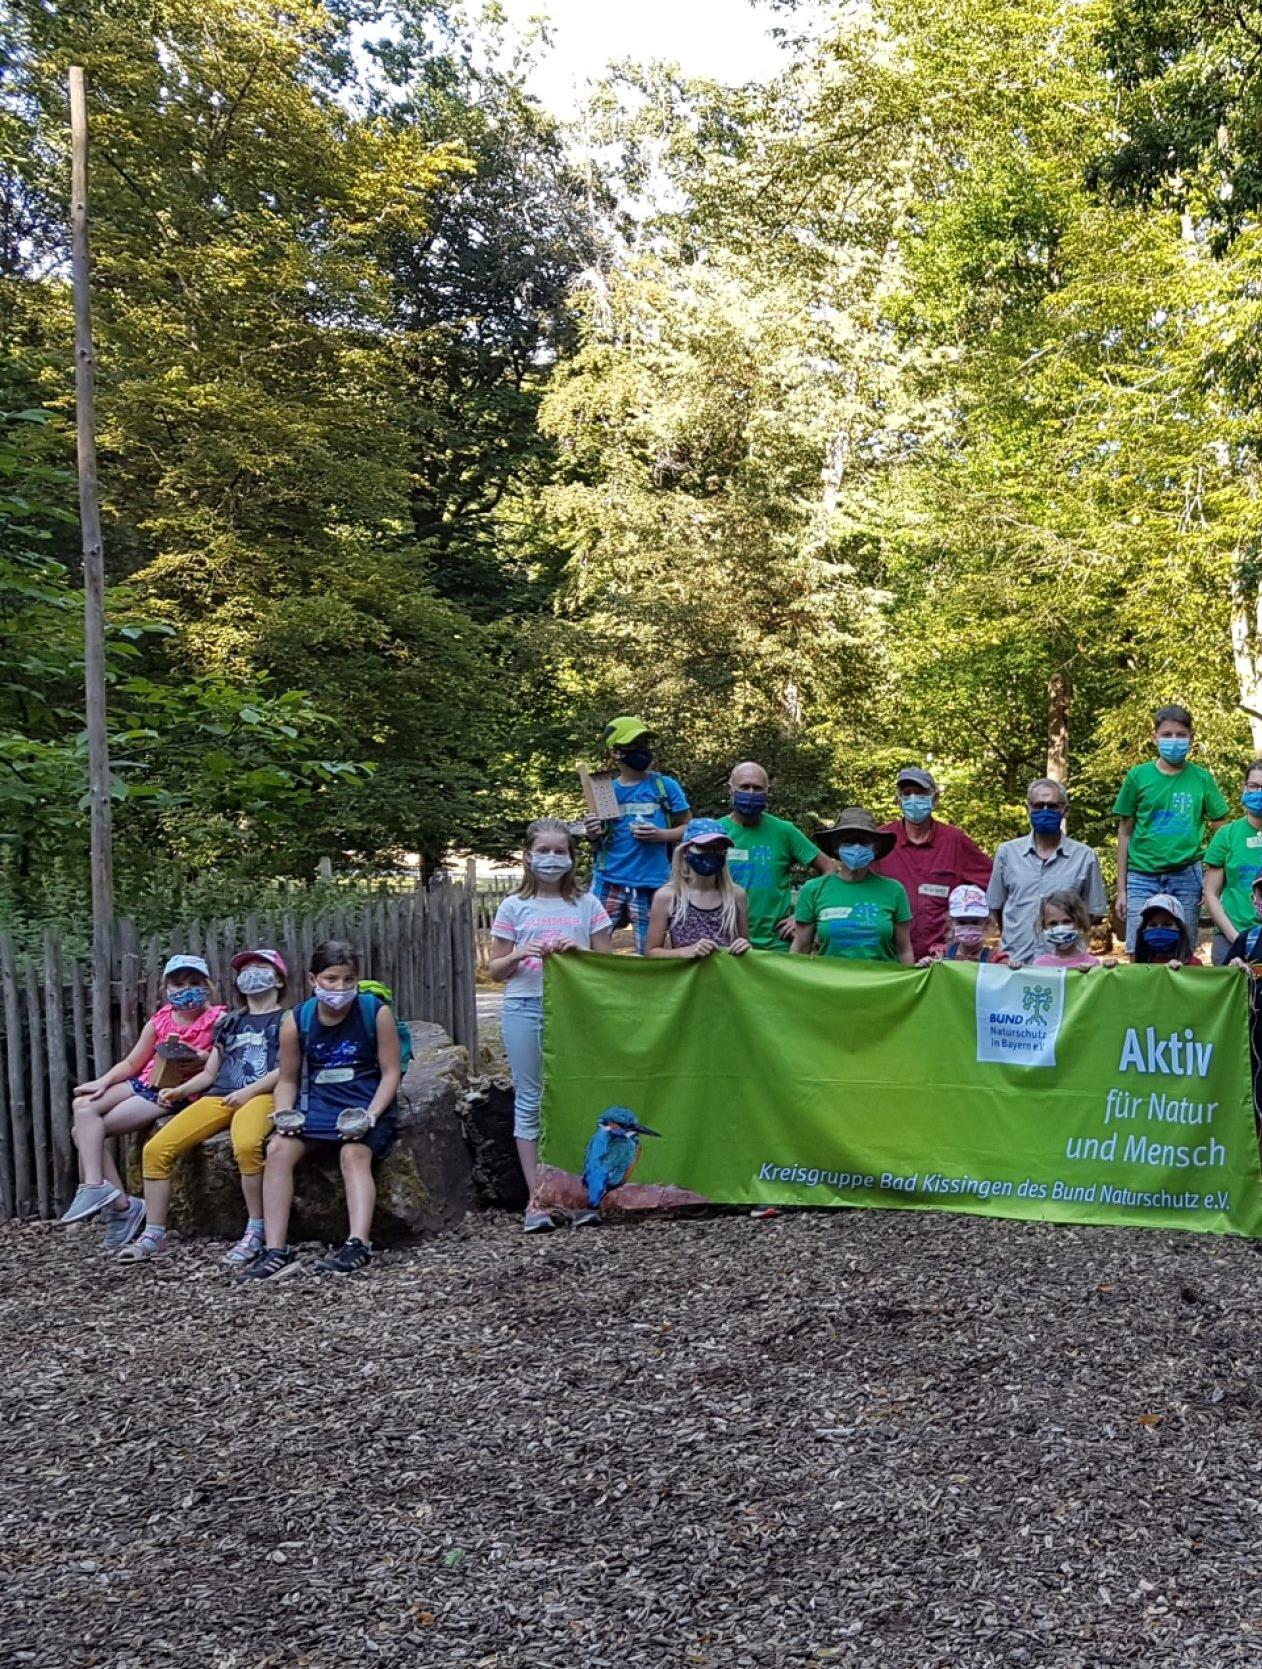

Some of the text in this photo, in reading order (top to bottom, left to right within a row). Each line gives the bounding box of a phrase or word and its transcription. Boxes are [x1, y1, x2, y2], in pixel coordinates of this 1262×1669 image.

[989, 1013, 1024, 1025] BUND
[990, 1027, 1048, 1039] Naturschutz
[991, 1038, 1000, 1047] in
[1001, 1038, 1032, 1051] Bayern
[1119, 1027, 1214, 1077] Aktiv
[1104, 1088, 1219, 1125] für Natur
[1066, 1132, 1225, 1168] und Mensch
[758, 1162, 1231, 1211] Kreisgruppe Bad Kissingen des Bund Naturschutz e.V.
